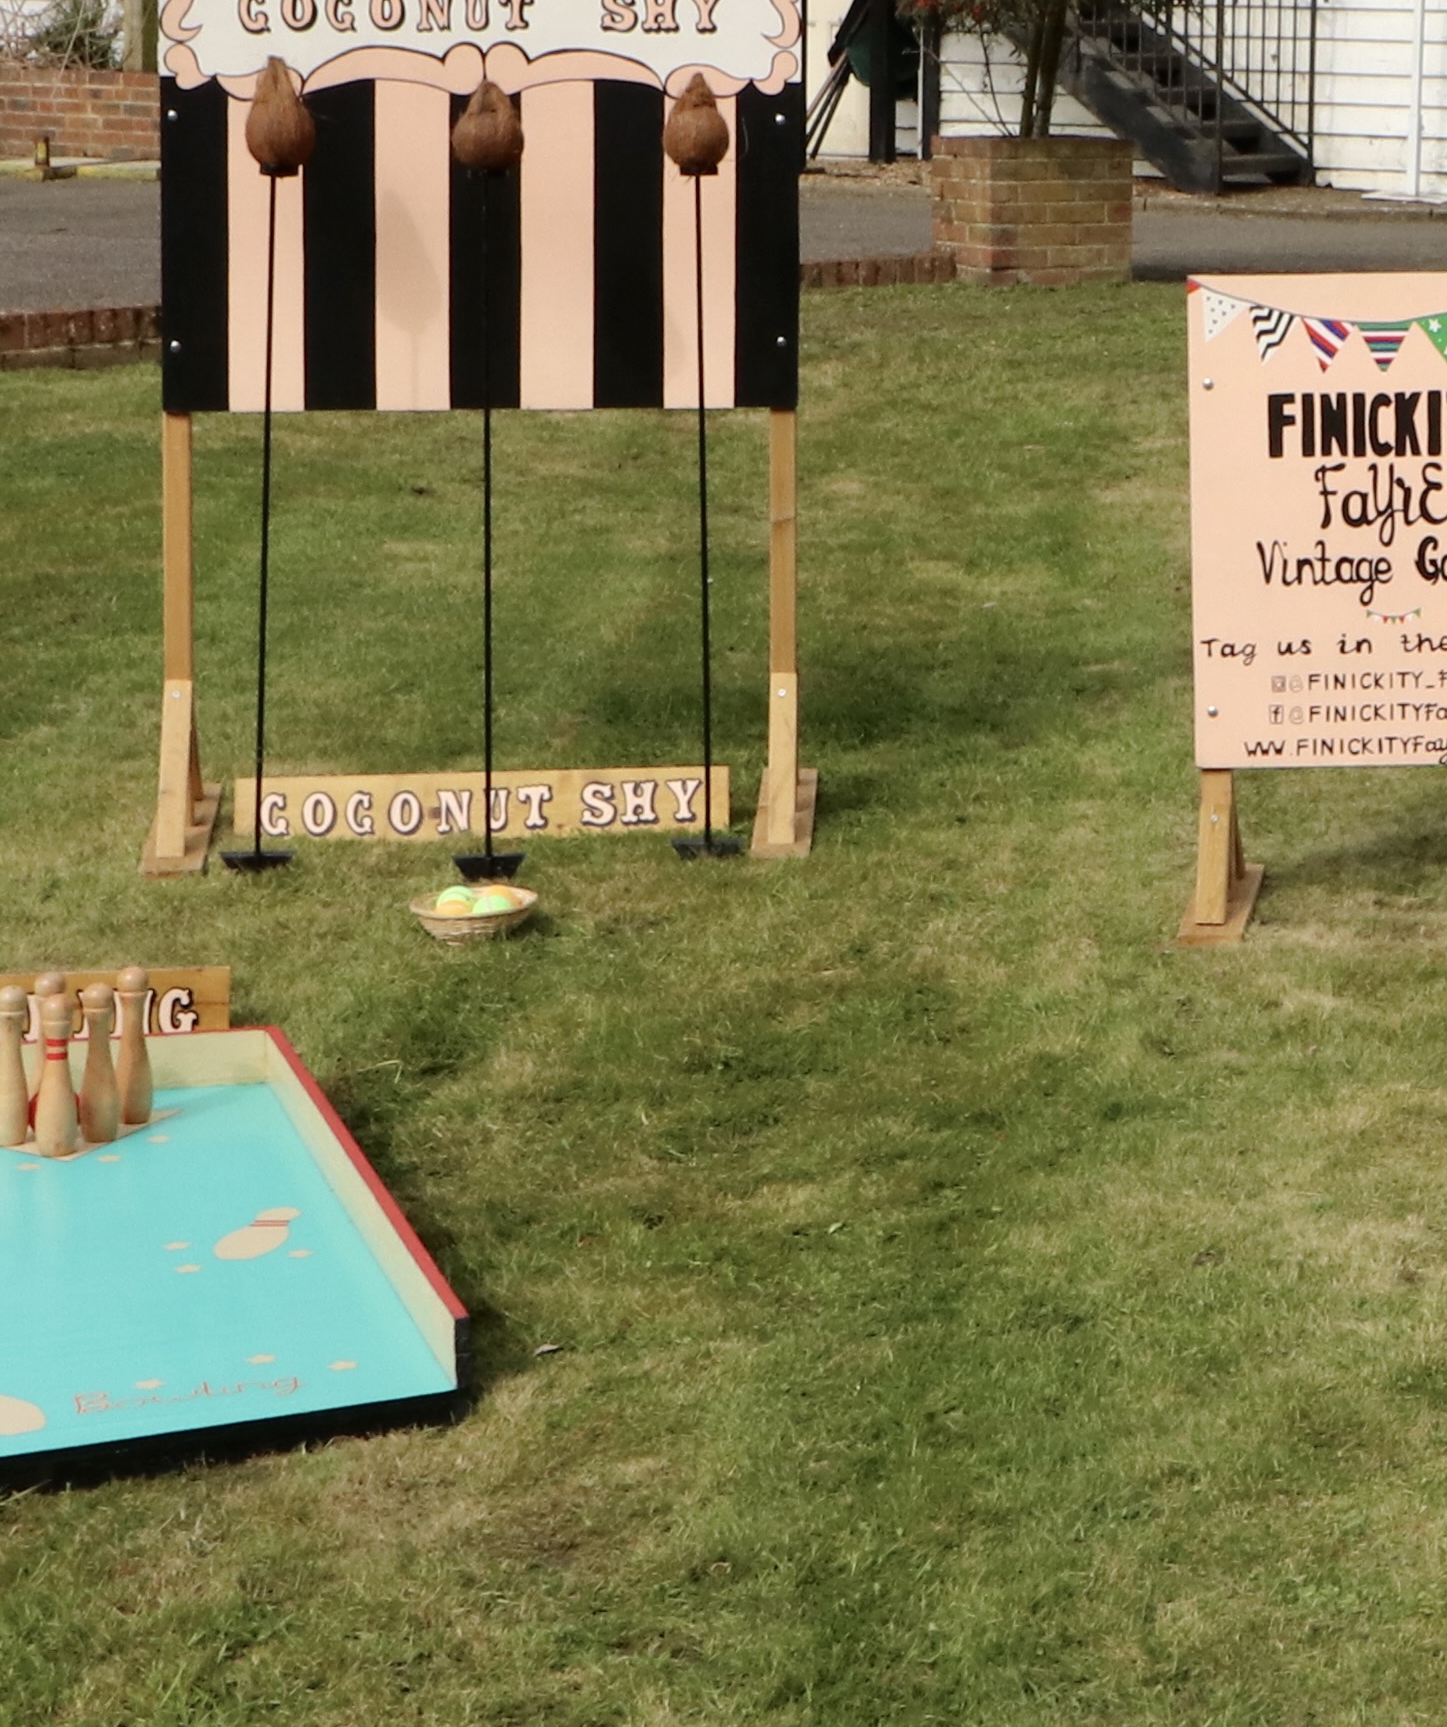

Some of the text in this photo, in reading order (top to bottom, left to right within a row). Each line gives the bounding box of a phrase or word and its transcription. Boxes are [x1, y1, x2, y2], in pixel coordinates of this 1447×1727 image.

[1255, 539, 1394, 607] Vintage
[1200, 638, 1258, 666] Tag
[1277, 638, 1312, 656] us
[1336, 633, 1373, 655] in
[259, 777, 703, 836] COCONUT SHY
